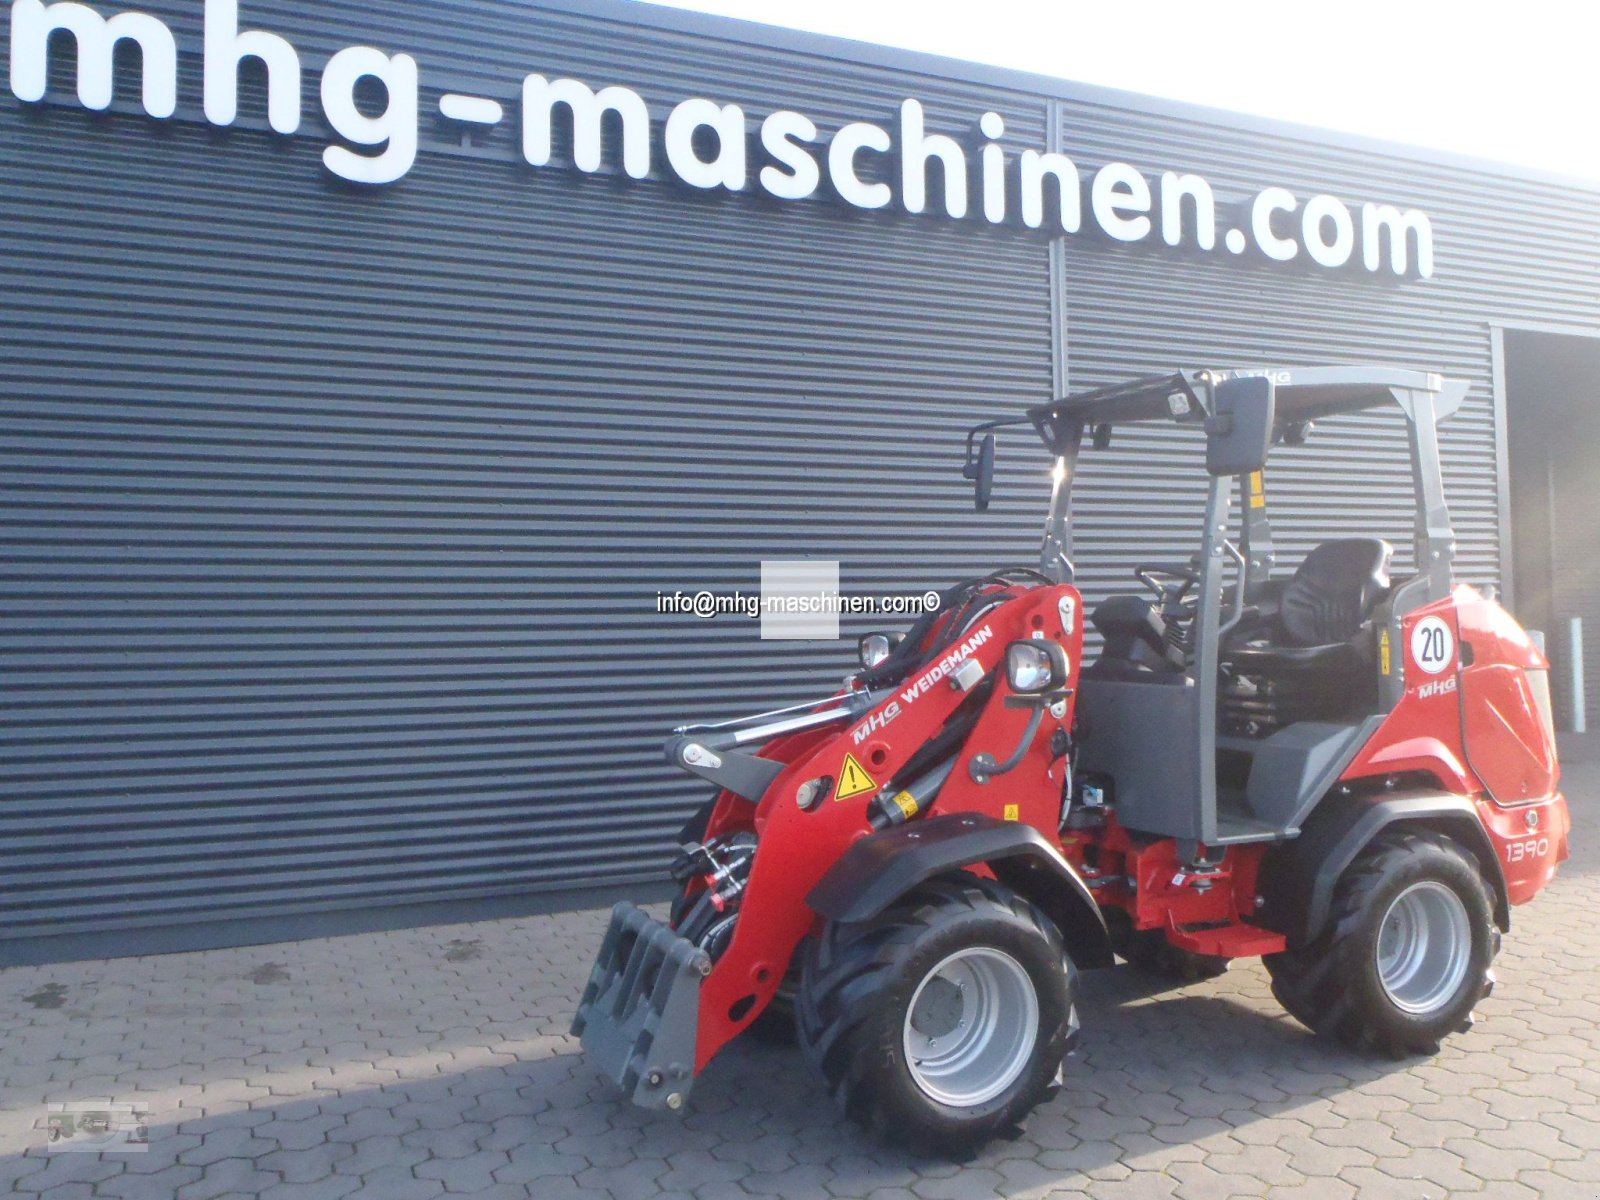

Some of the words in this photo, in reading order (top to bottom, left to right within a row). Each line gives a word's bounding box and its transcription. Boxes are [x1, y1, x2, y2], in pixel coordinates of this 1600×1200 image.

[10, 0, 1434, 279] mhg-maschinen.com
[1421, 627, 1444, 662] 20
[852, 701, 901, 745] MHG
[901, 625, 993, 703] WEIDEMANN
[1418, 676, 1457, 699] MHG
[1505, 838, 1549, 863] 1390
